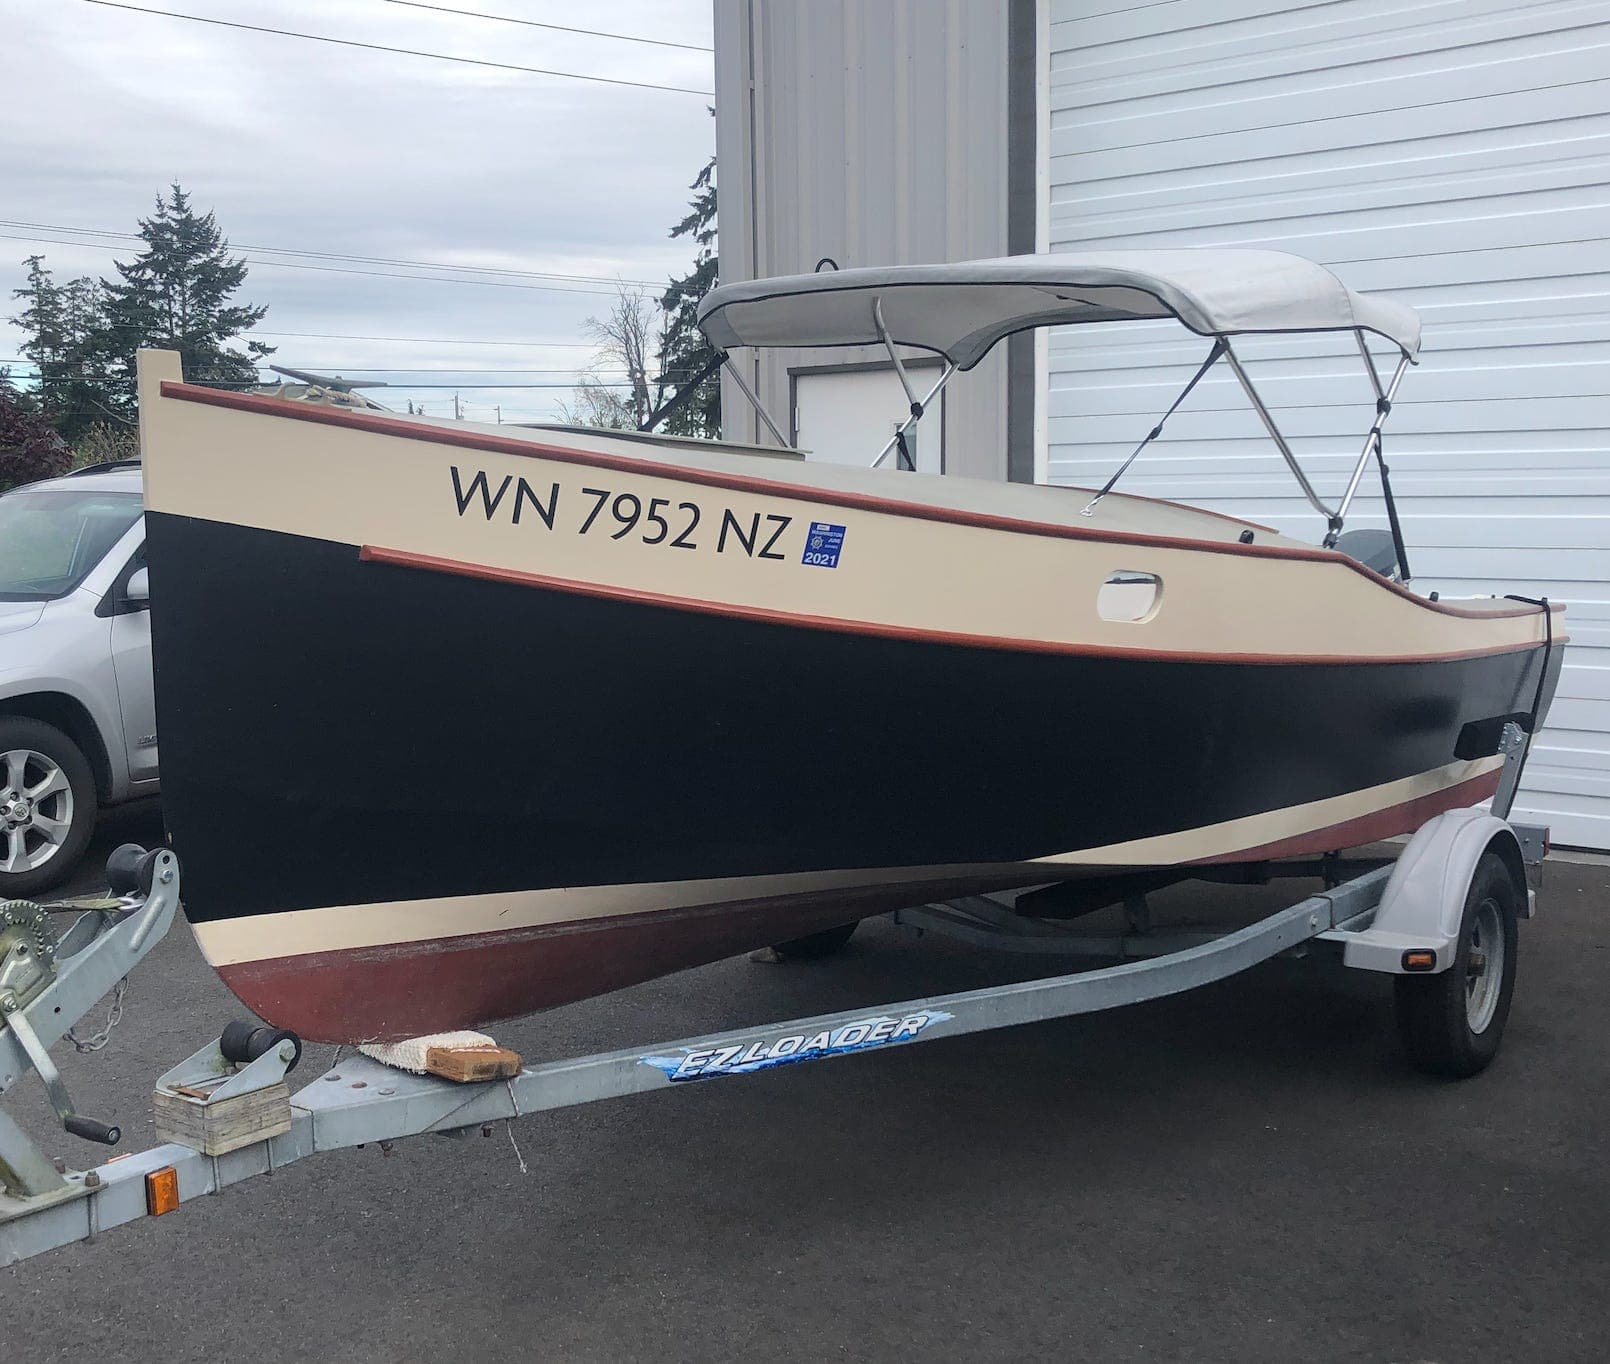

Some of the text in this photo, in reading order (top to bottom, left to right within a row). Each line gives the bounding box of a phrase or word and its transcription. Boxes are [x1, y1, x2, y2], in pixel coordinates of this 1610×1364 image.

[450, 465, 792, 560] WN 7952 NZ
[804, 552, 836, 566] 2021
[737, 1015, 930, 1064] LOADER
